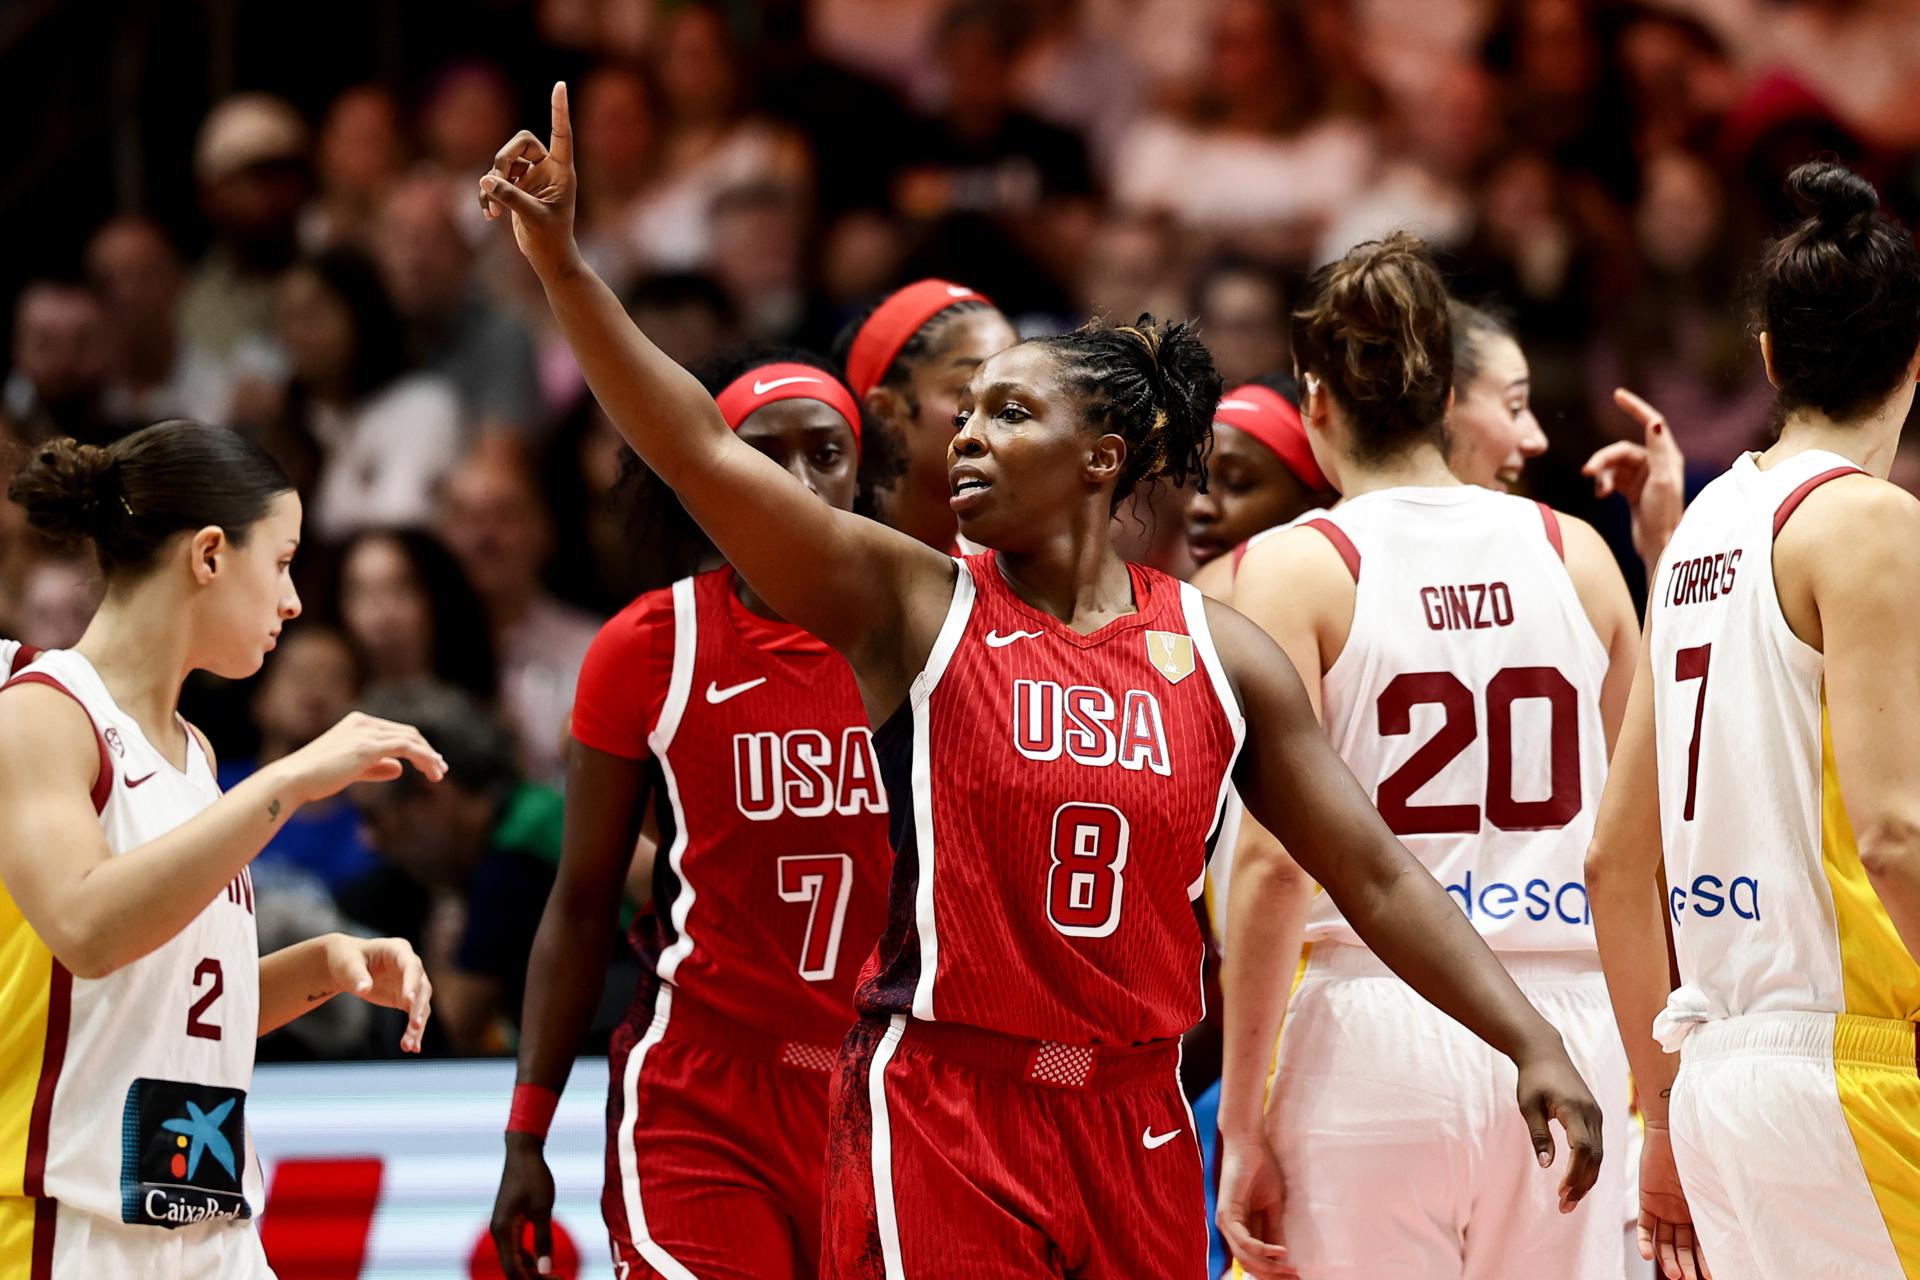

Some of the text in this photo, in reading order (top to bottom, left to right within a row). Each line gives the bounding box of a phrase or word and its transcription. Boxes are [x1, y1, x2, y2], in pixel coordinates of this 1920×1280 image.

[1420, 582, 1515, 631] GINZO
[733, 727, 889, 821] USA
[1012, 679, 1172, 777] USA
[1377, 667, 1582, 835] 20
[1675, 643, 1711, 821] 7
[777, 853, 853, 982] 7
[1046, 801, 1129, 938] 8
[186, 957, 224, 1041] 2
